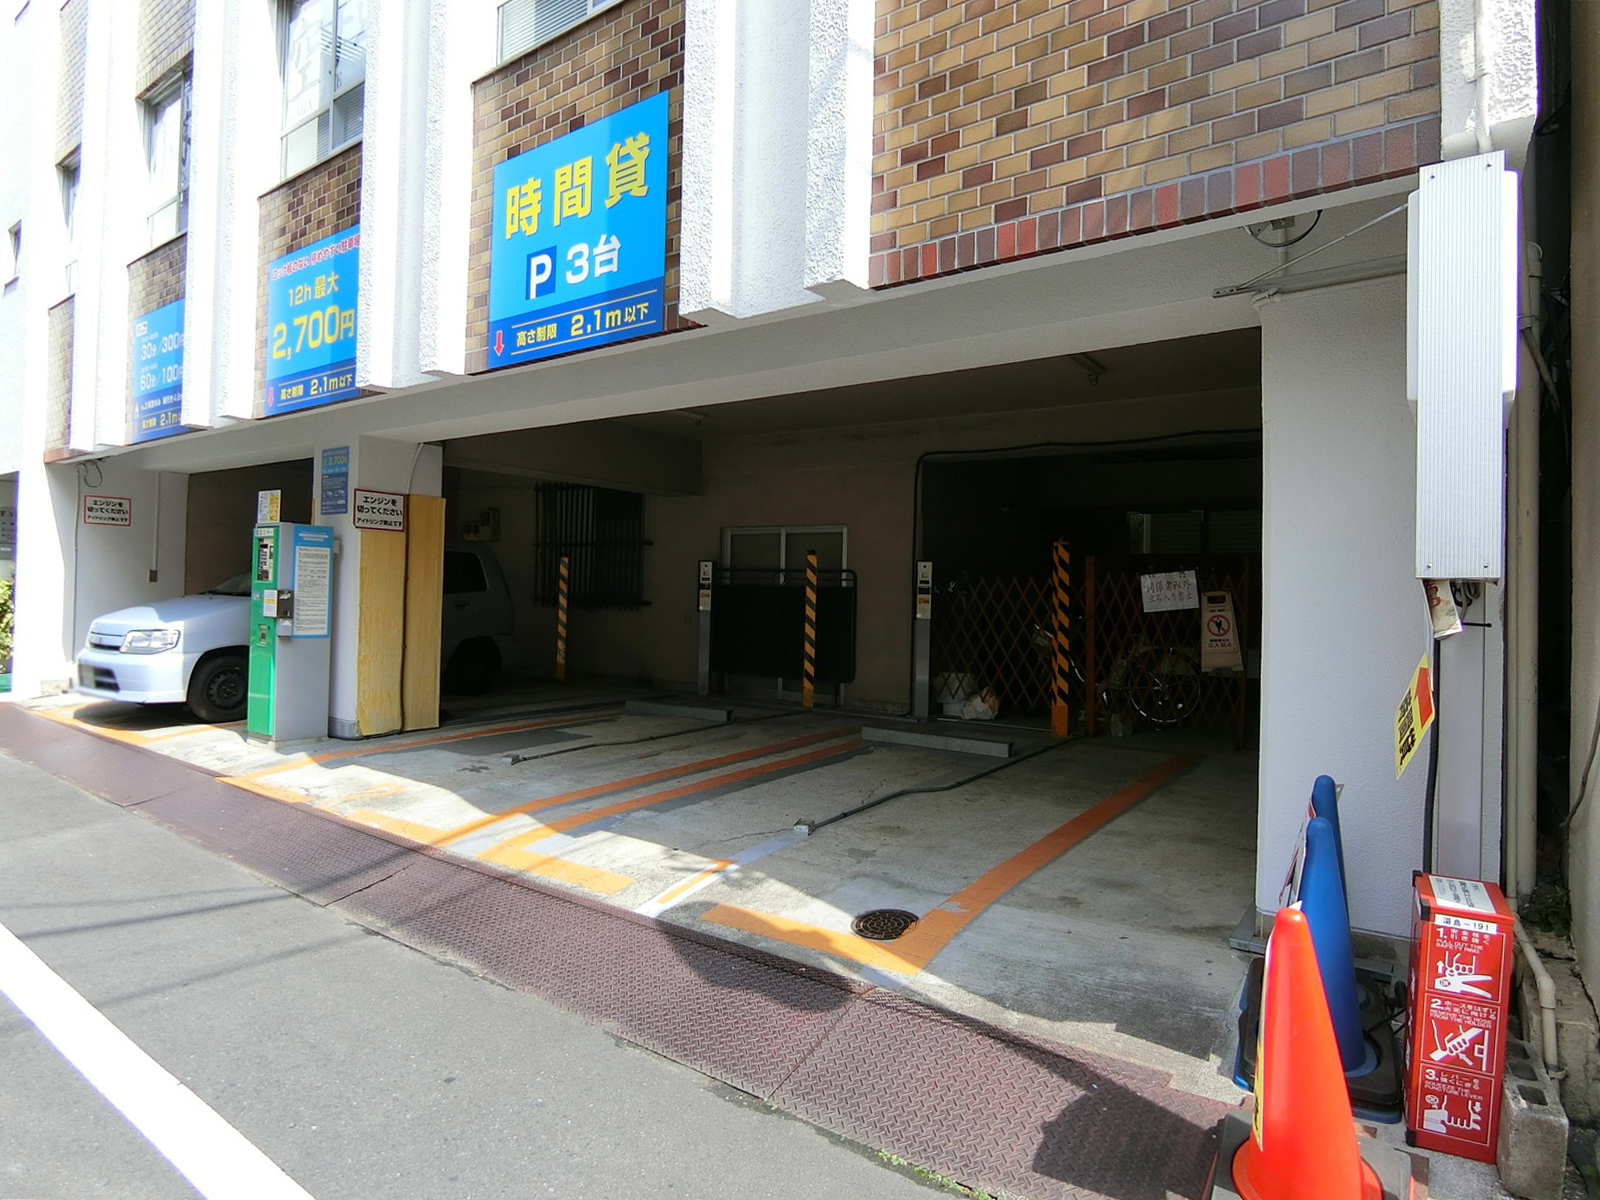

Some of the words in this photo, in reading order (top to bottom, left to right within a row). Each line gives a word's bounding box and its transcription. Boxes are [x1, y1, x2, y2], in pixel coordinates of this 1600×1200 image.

[505, 131, 650, 239] 時間貸
[530, 254, 551, 299] P
[565, 234, 622, 285] 3台
[288, 283, 311, 307] 12h
[314, 271, 339, 299] 最大
[272, 304, 355, 361] 2,700円
[516, 323, 557, 347] 高さ制限
[87, 506, 128, 515] 切ってください
[357, 505, 402, 516] 切ってください
[363, 496, 397, 506] エンジンを
